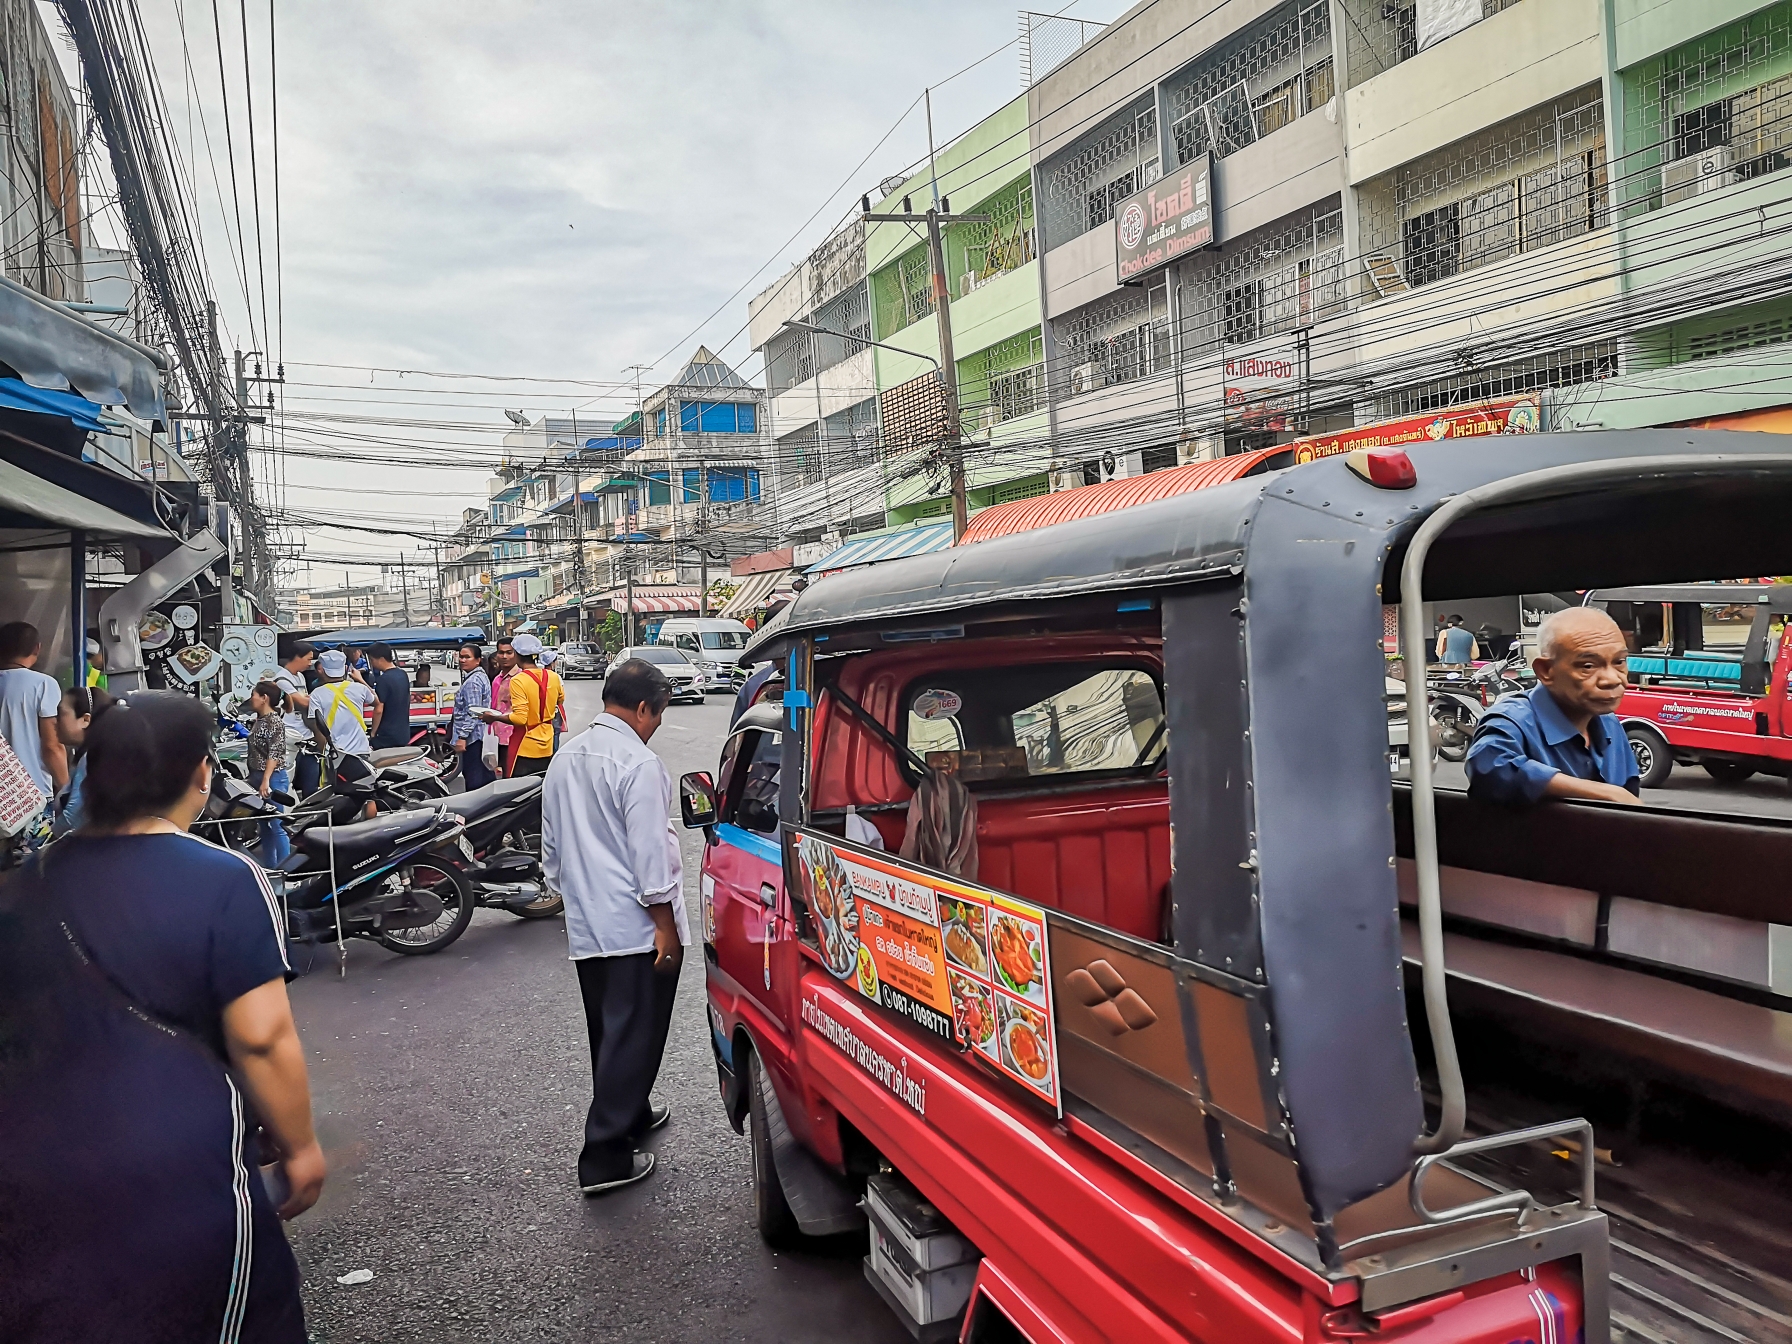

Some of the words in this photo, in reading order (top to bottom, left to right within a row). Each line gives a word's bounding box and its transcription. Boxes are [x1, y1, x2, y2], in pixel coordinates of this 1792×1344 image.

[1147, 173, 1194, 227] โชคดี
[1119, 248, 1163, 277] Chokdee
[1166, 226, 1211, 257] Dimsum
[1225, 358, 1292, 379] ส.แสงทอง
[938, 698, 957, 709] 1669
[352, 854, 380, 870] SUZUKI
[852, 871, 886, 899] BANKAMPU
[898, 883, 935, 923] บ้านก้ามปู
[892, 991, 950, 1039] 087-1098777
